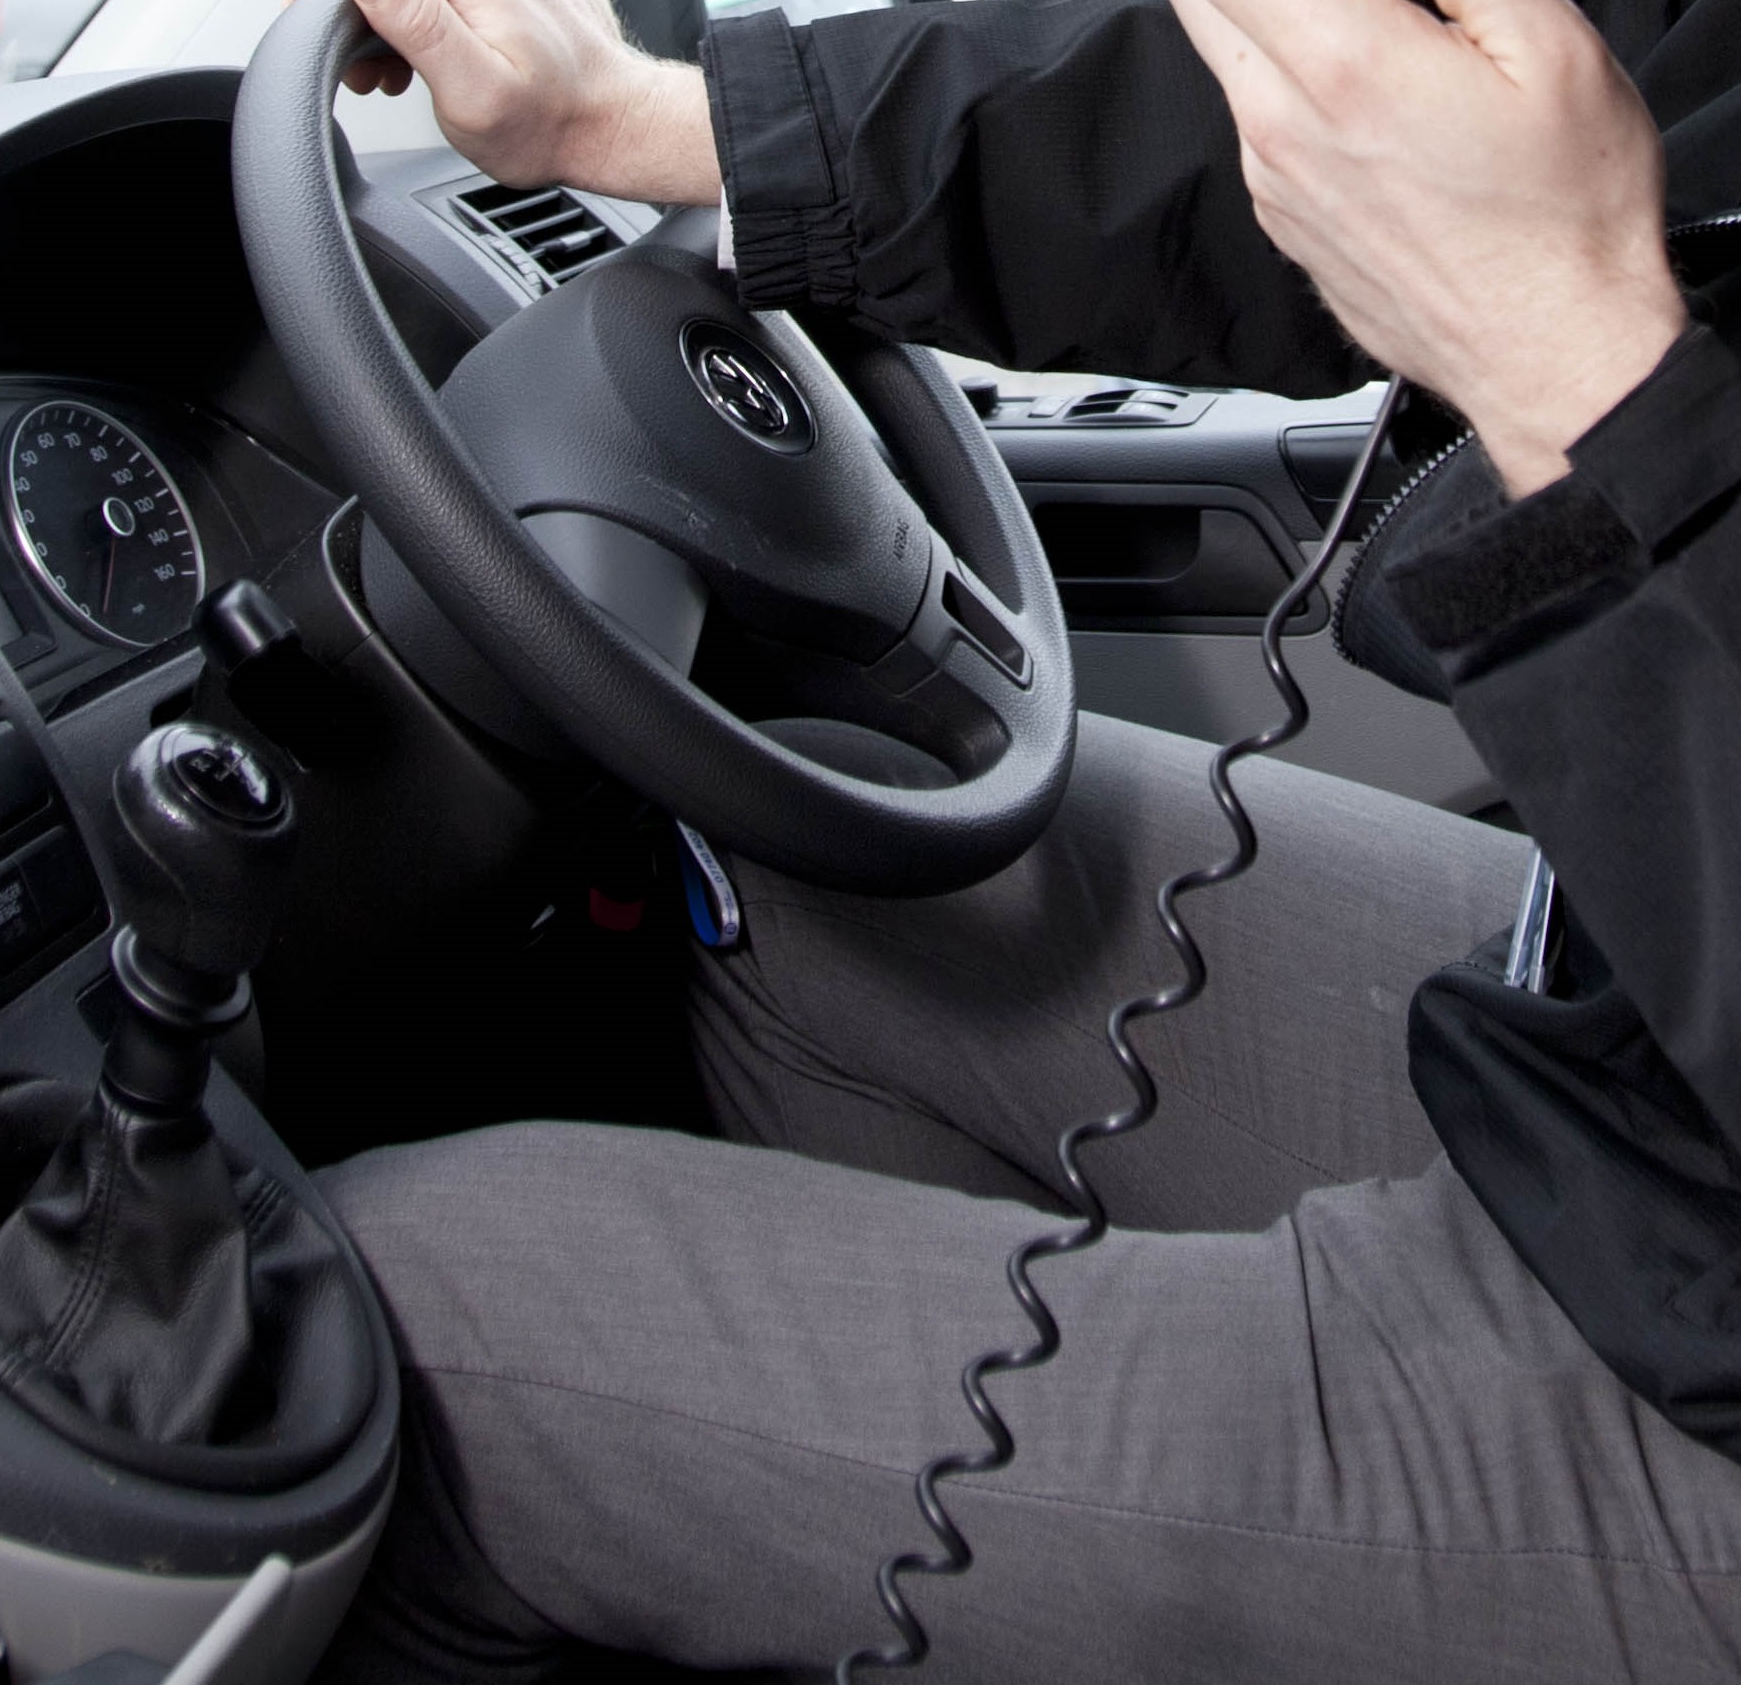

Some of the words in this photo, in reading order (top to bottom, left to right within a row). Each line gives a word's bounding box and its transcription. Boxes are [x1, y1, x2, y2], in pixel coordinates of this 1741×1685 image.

[37, 432, 55, 448] 60
[63, 432, 81, 449] 70
[20, 449, 38, 467] 50
[89, 445, 108, 462] 80
[111, 468, 134, 486] 100
[133, 496, 155, 514] 120
[147, 528, 170, 546] 140
[153, 563, 176, 581] 160
